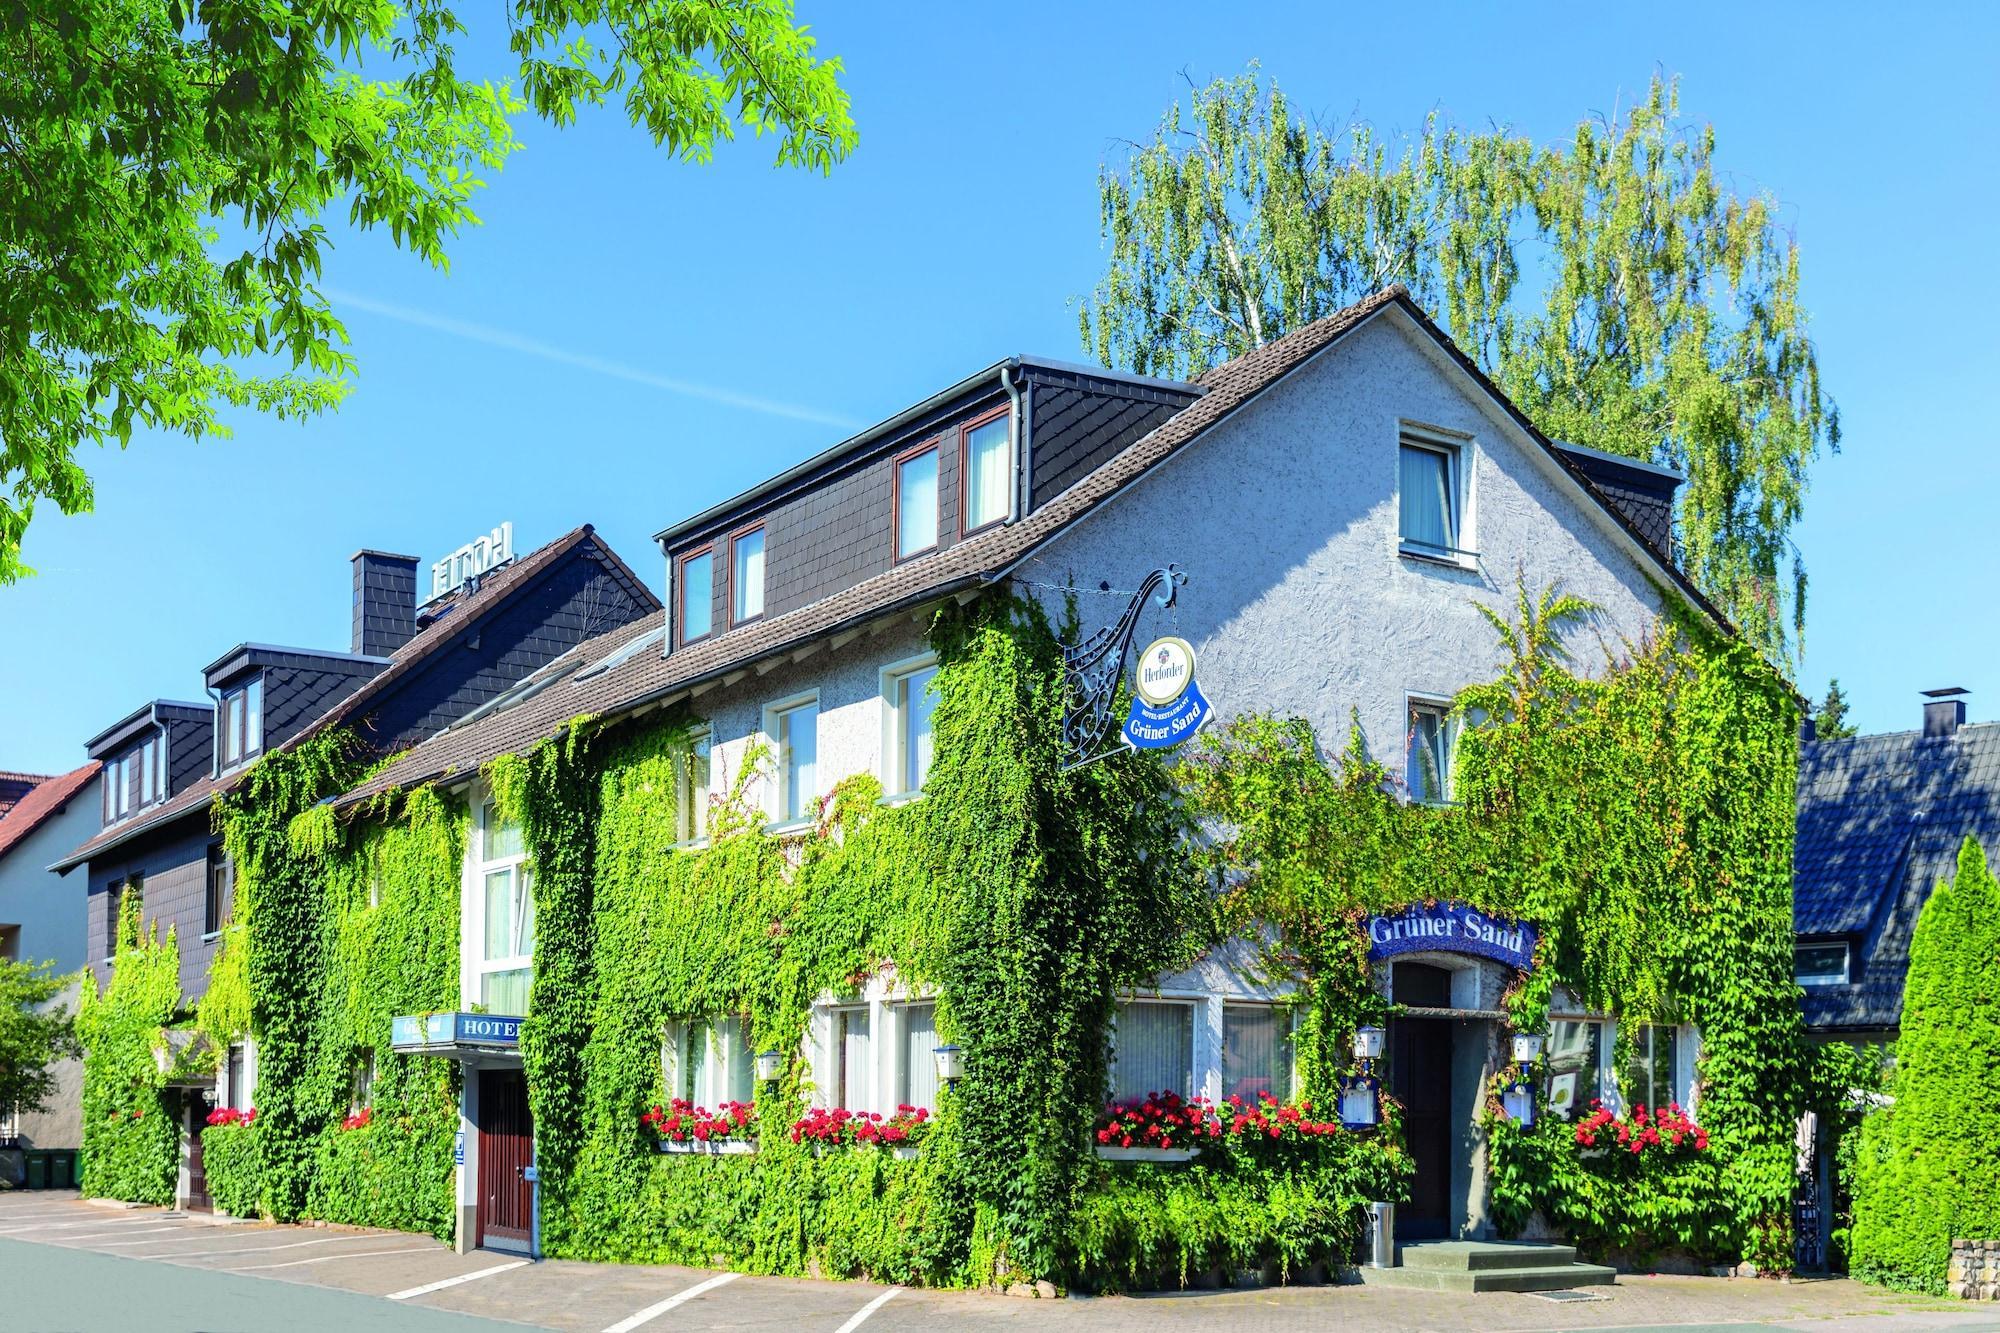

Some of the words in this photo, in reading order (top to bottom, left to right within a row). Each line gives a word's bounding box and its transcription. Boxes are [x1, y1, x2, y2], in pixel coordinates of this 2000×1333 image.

[1144, 662, 1184, 683] Herforder
[1130, 719, 1170, 740] Grüner
[1172, 702, 1201, 735] Sand
[1369, 912, 1457, 944] Grüner
[1464, 913, 1524, 953] Sand
